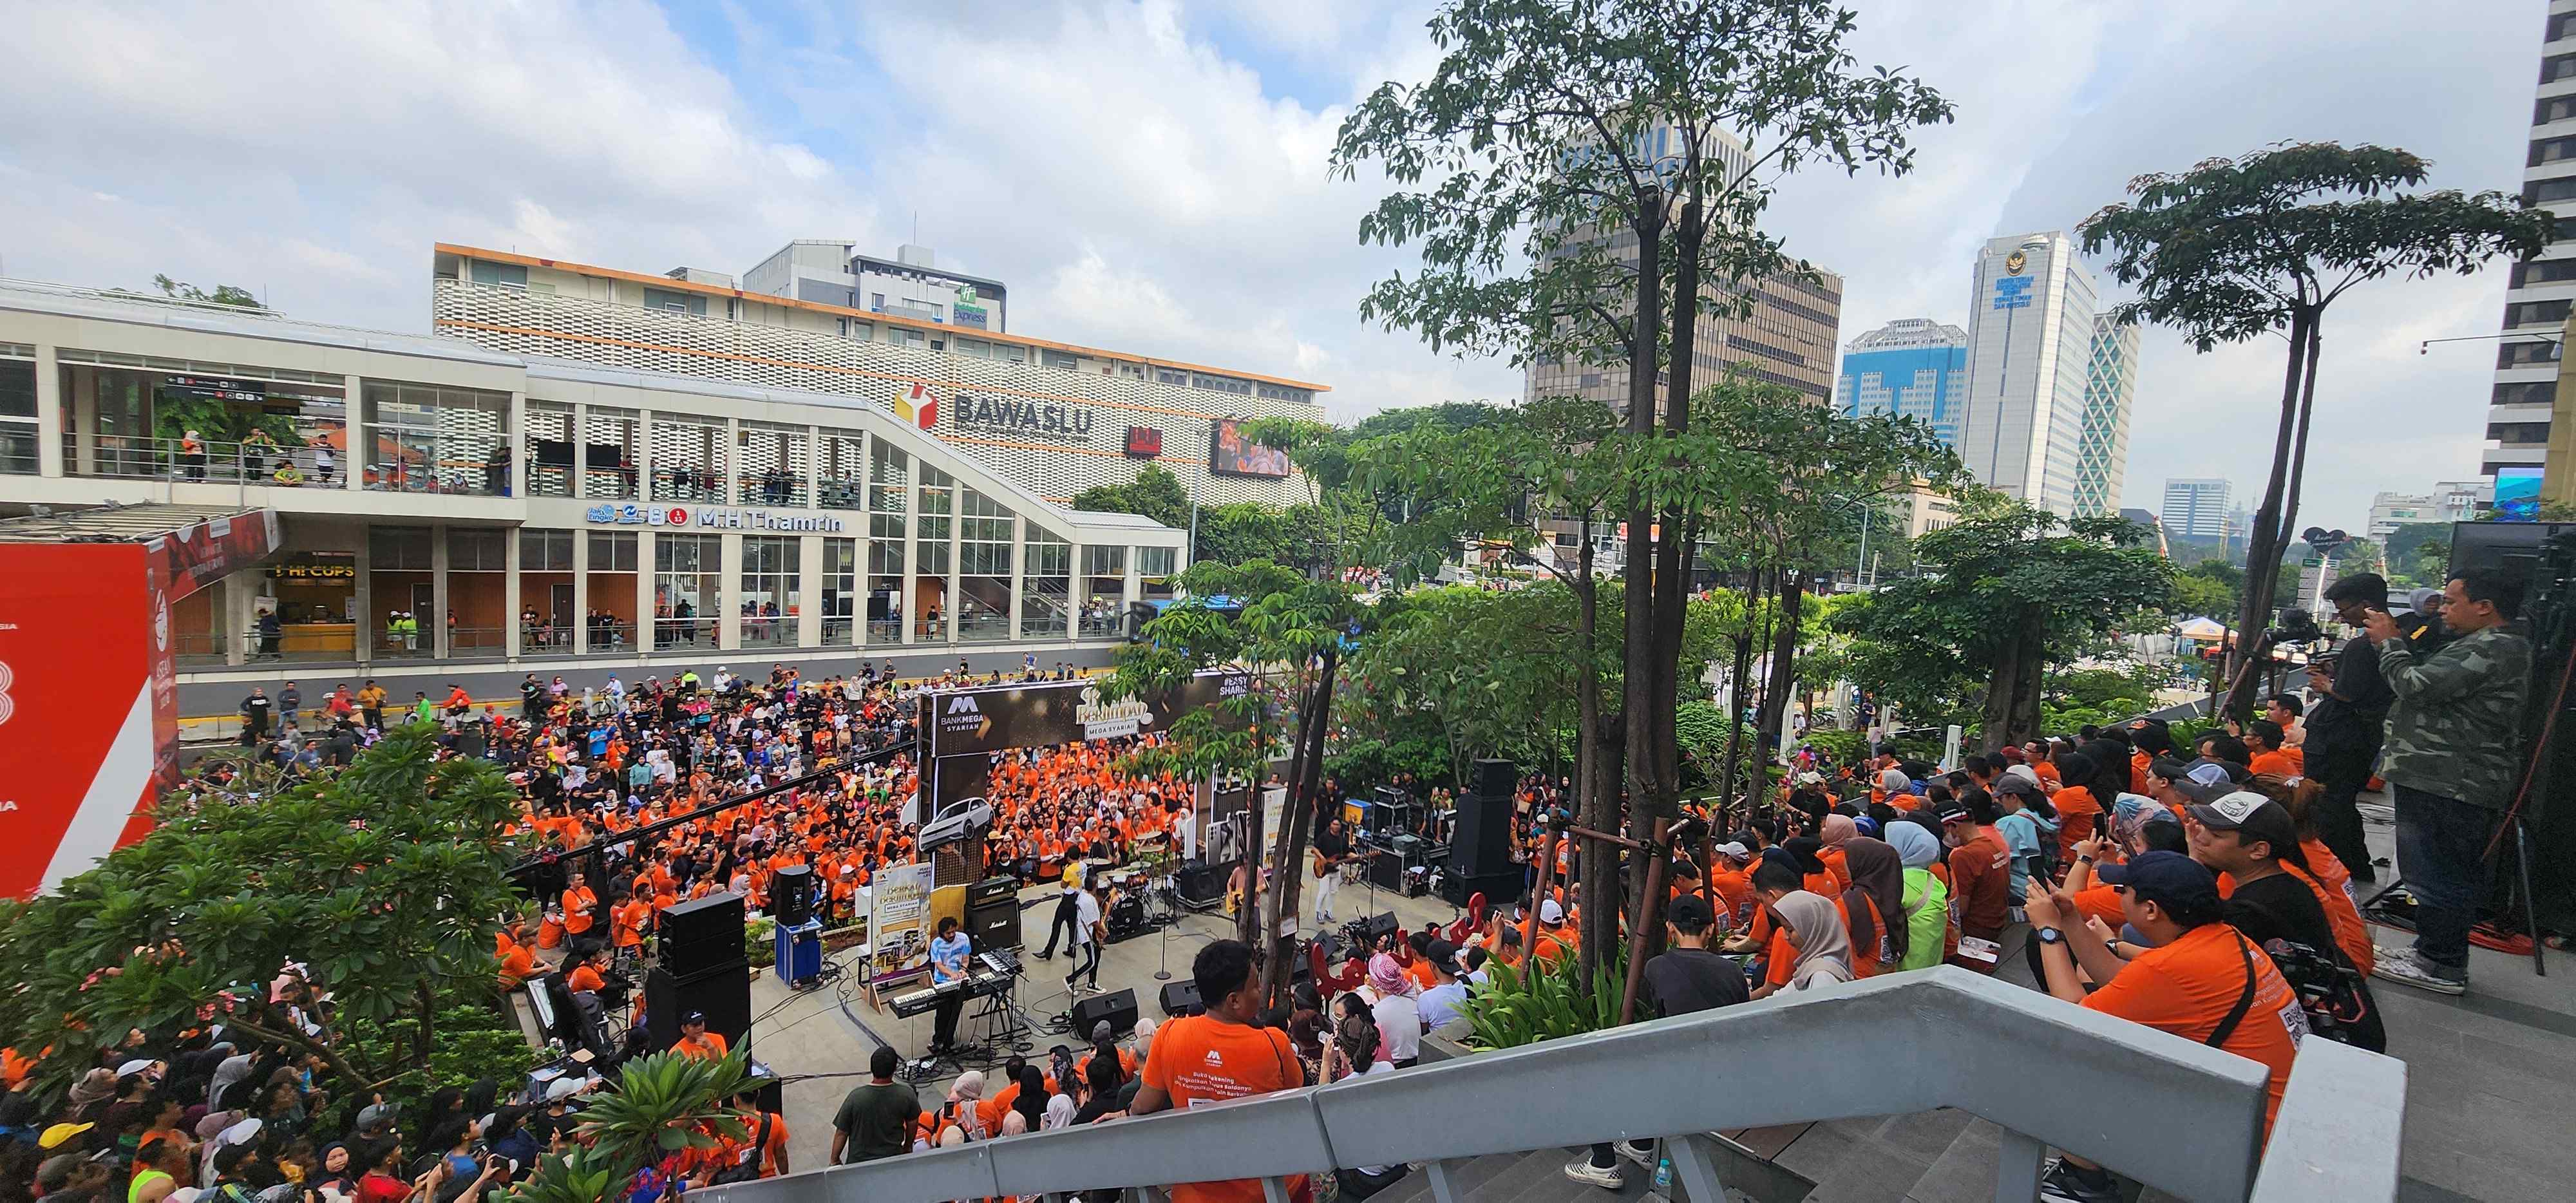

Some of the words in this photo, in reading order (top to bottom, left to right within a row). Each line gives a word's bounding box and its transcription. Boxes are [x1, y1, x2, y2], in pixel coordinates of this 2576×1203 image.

[954, 394, 1092, 435] BAWASLU
[310, 565, 354, 576] CUPS
[1224, 676, 1247, 687] #EASY
[947, 723, 979, 732] SYARIAH
[1109, 723, 1135, 733] SYARIAH
